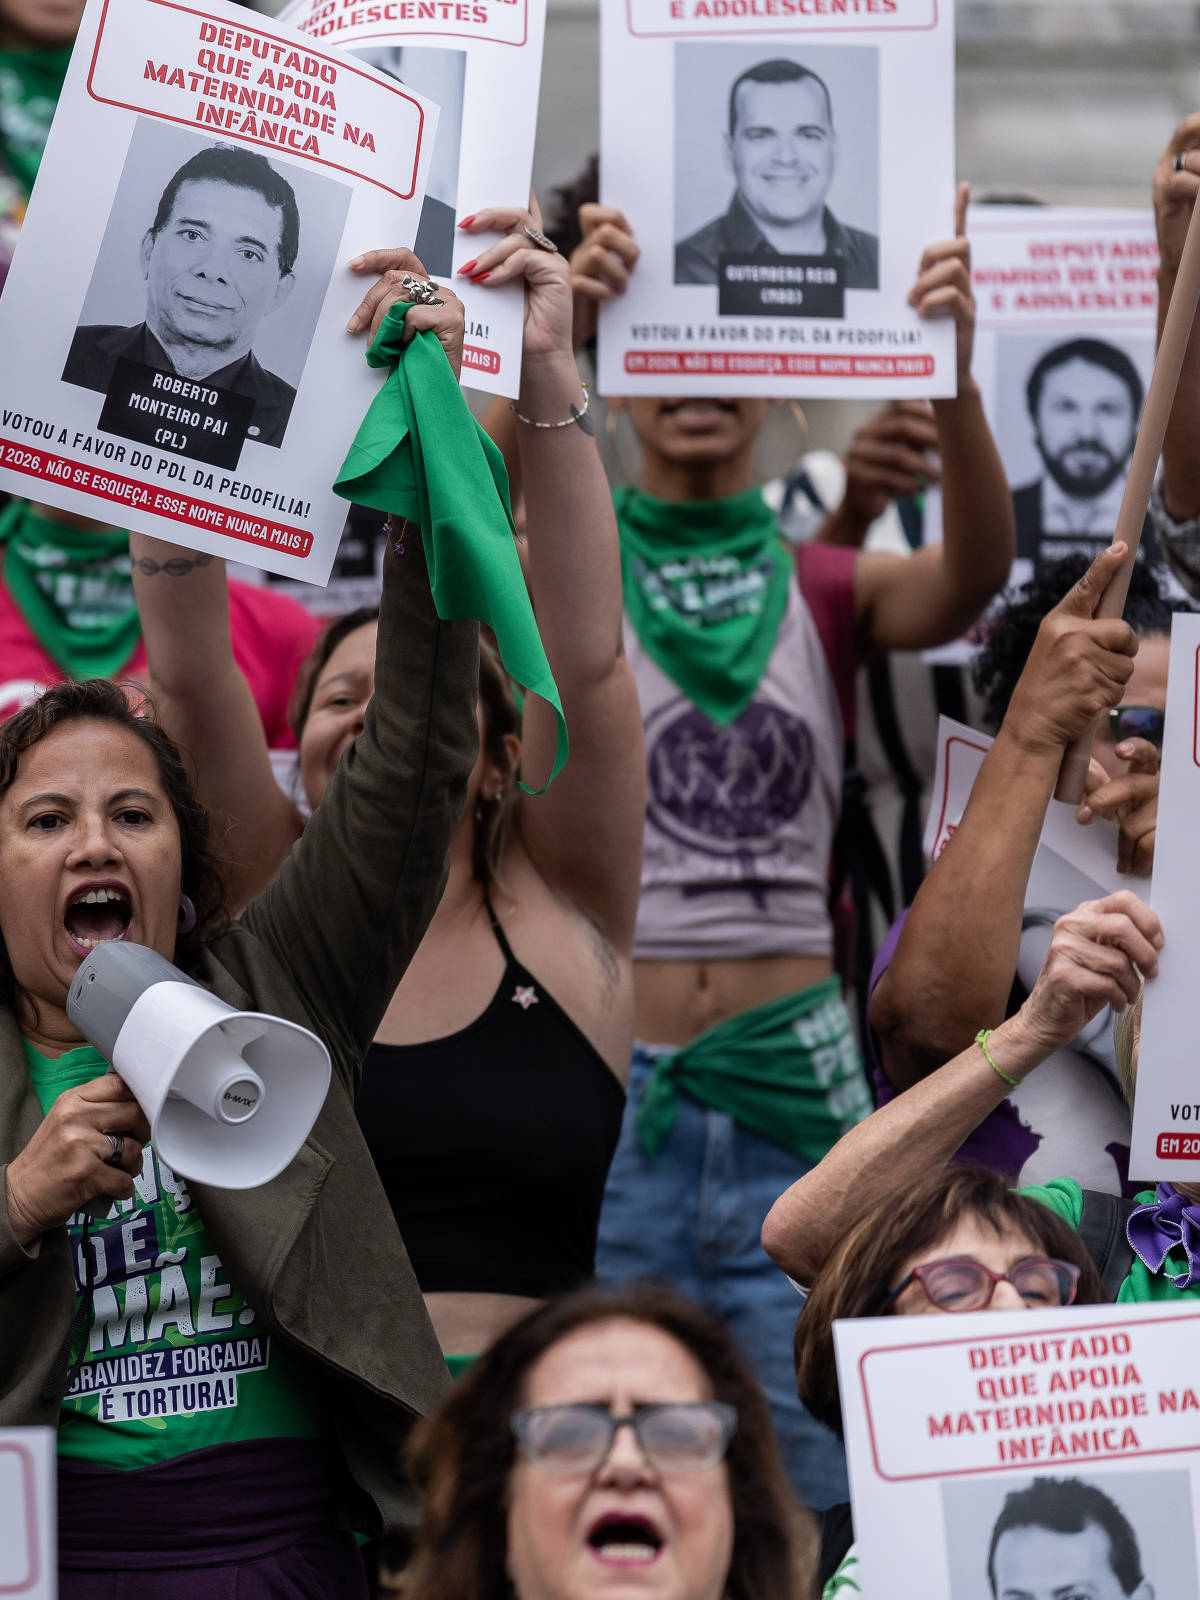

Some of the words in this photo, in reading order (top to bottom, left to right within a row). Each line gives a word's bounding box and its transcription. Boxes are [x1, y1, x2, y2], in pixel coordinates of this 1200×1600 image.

[199, 21, 338, 85] DEPUTADO
[197, 49, 251, 81] QUE
[257, 68, 337, 111] APOIA
[143, 60, 337, 135] MATERNIDADE
[343, 122, 376, 154] NA
[195, 101, 320, 156] INFÂNICA
[463, 349, 490, 367] MAIS
[493, 357, 497, 369] !
[152, 373, 219, 405] ROBERTO
[128, 392, 201, 427] MONTEIRO
[203, 416, 228, 436] PAI
[154, 428, 187, 449] (PL)
[2, 409, 55, 440] VOTOU
[57, 429, 68, 445] A
[72, 432, 126, 462] FAVOR
[129, 450, 152, 470] DO
[156, 458, 187, 482] PDL
[192, 470, 213, 490] DA
[218, 478, 311, 519] PEDOFILIA!
[5, 448, 42, 474] 2026,
[46, 459, 72, 480] NÃO
[73, 469, 91, 486] SE
[91, 474, 152, 506] ESQUEÇA:
[154, 493, 187, 516] ESSE
[188, 504, 225, 527] NOME
[225, 516, 267, 540] NUNCA
[269, 528, 301, 549] MAIS
[303, 538, 309, 552] !
[1170, 1104, 1200, 1120] VOT
[1160, 1138, 1180, 1153] EM
[1182, 1138, 1200, 1154] 20
[121, 1209, 152, 1274] É
[172, 1338, 262, 1375] FORÇADA
[968, 1332, 1132, 1370] DEPUTADO
[101, 1388, 116, 1421] É
[122, 1377, 236, 1418] TORTURA!
[977, 1374, 1038, 1402] QUE
[1049, 1363, 1141, 1394] APOIA
[928, 1393, 1148, 1439] MATERNIDADE
[1158, 1388, 1199, 1413] NA
[998, 1426, 1140, 1462] INFÂNICA
